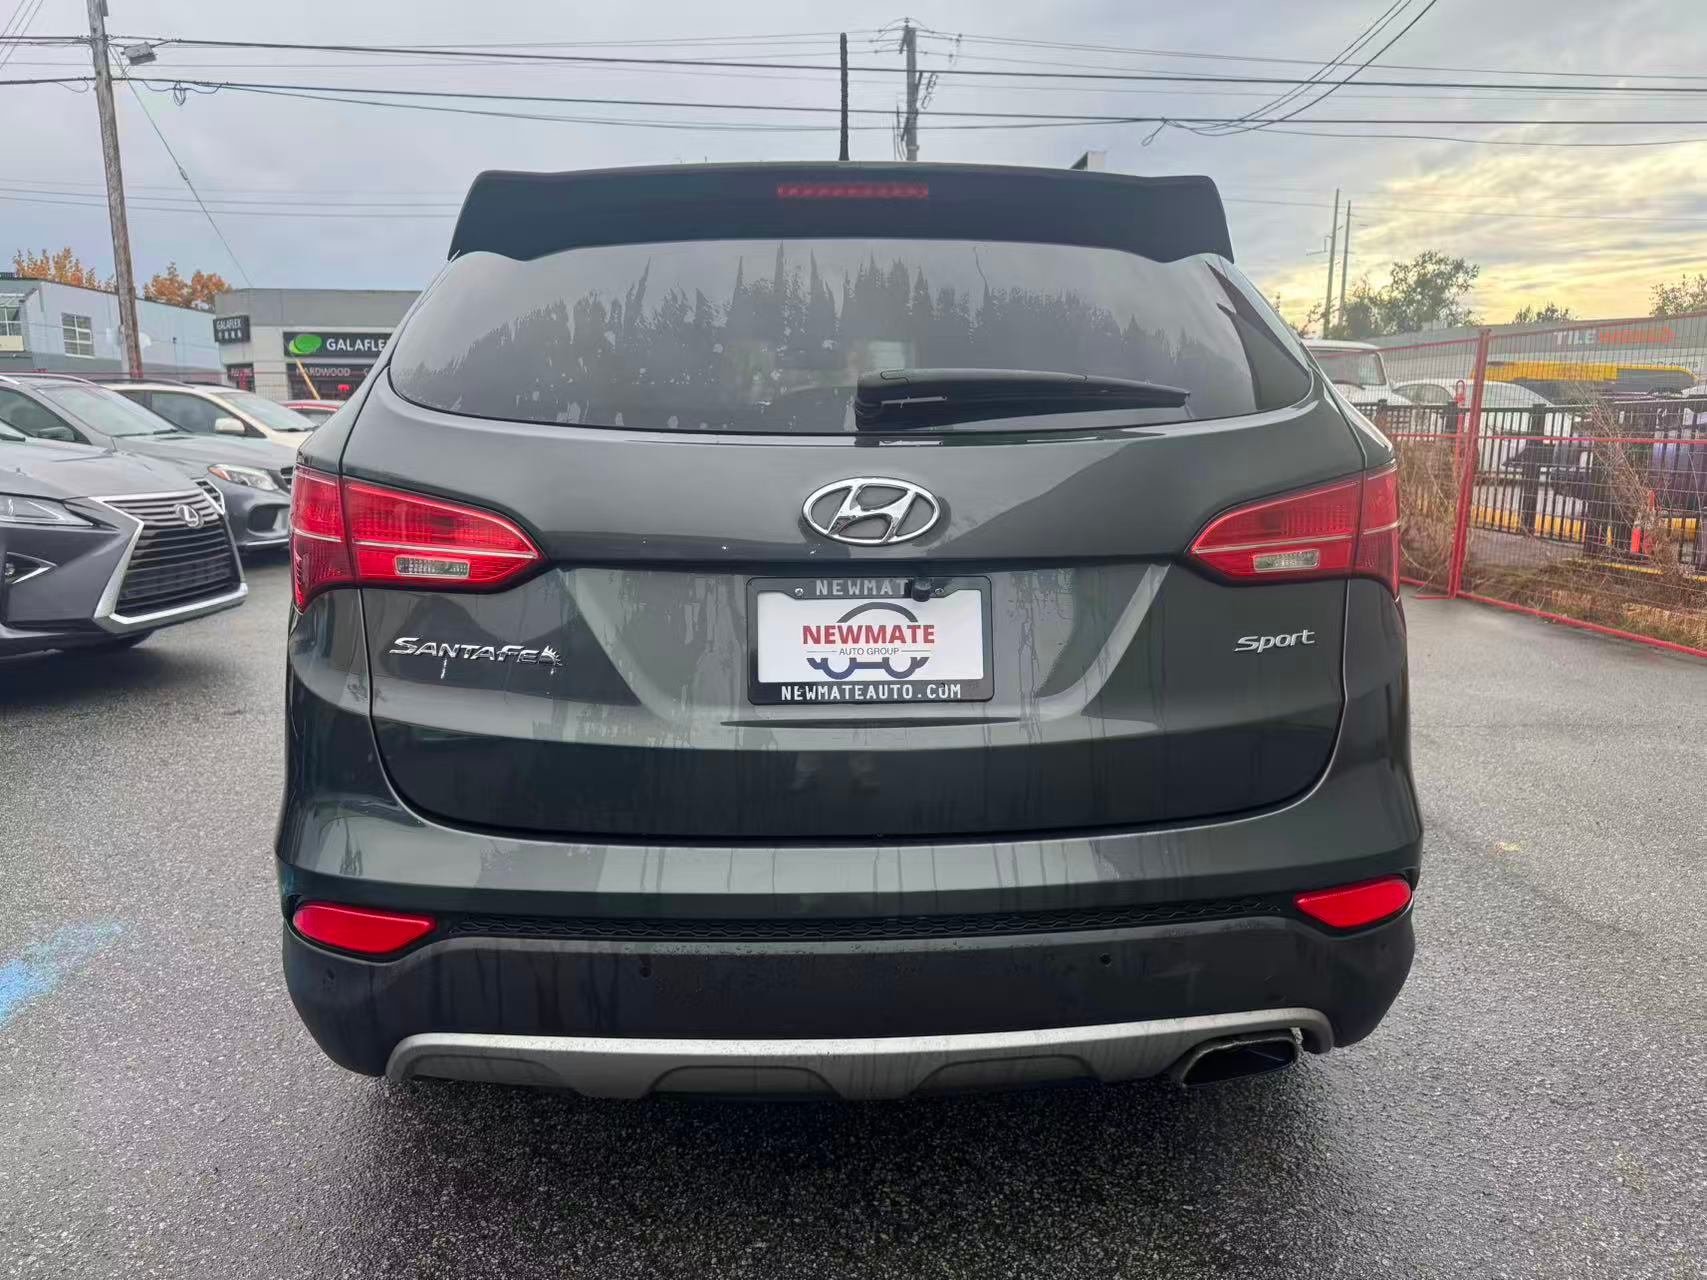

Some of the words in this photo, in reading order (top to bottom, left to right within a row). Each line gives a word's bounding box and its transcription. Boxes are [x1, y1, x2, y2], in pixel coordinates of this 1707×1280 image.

[326, 338, 388, 352] GALAFLE
[1553, 329, 1596, 345] TILE
[816, 579, 908, 596] NEWMAT
[802, 624, 935, 645] NEWMATE
[1233, 629, 1316, 653] Sport
[839, 647, 865, 656] AUTO
[866, 647, 900, 656] GROUP
[781, 683, 962, 701] NEWMATEAUTO.COM
